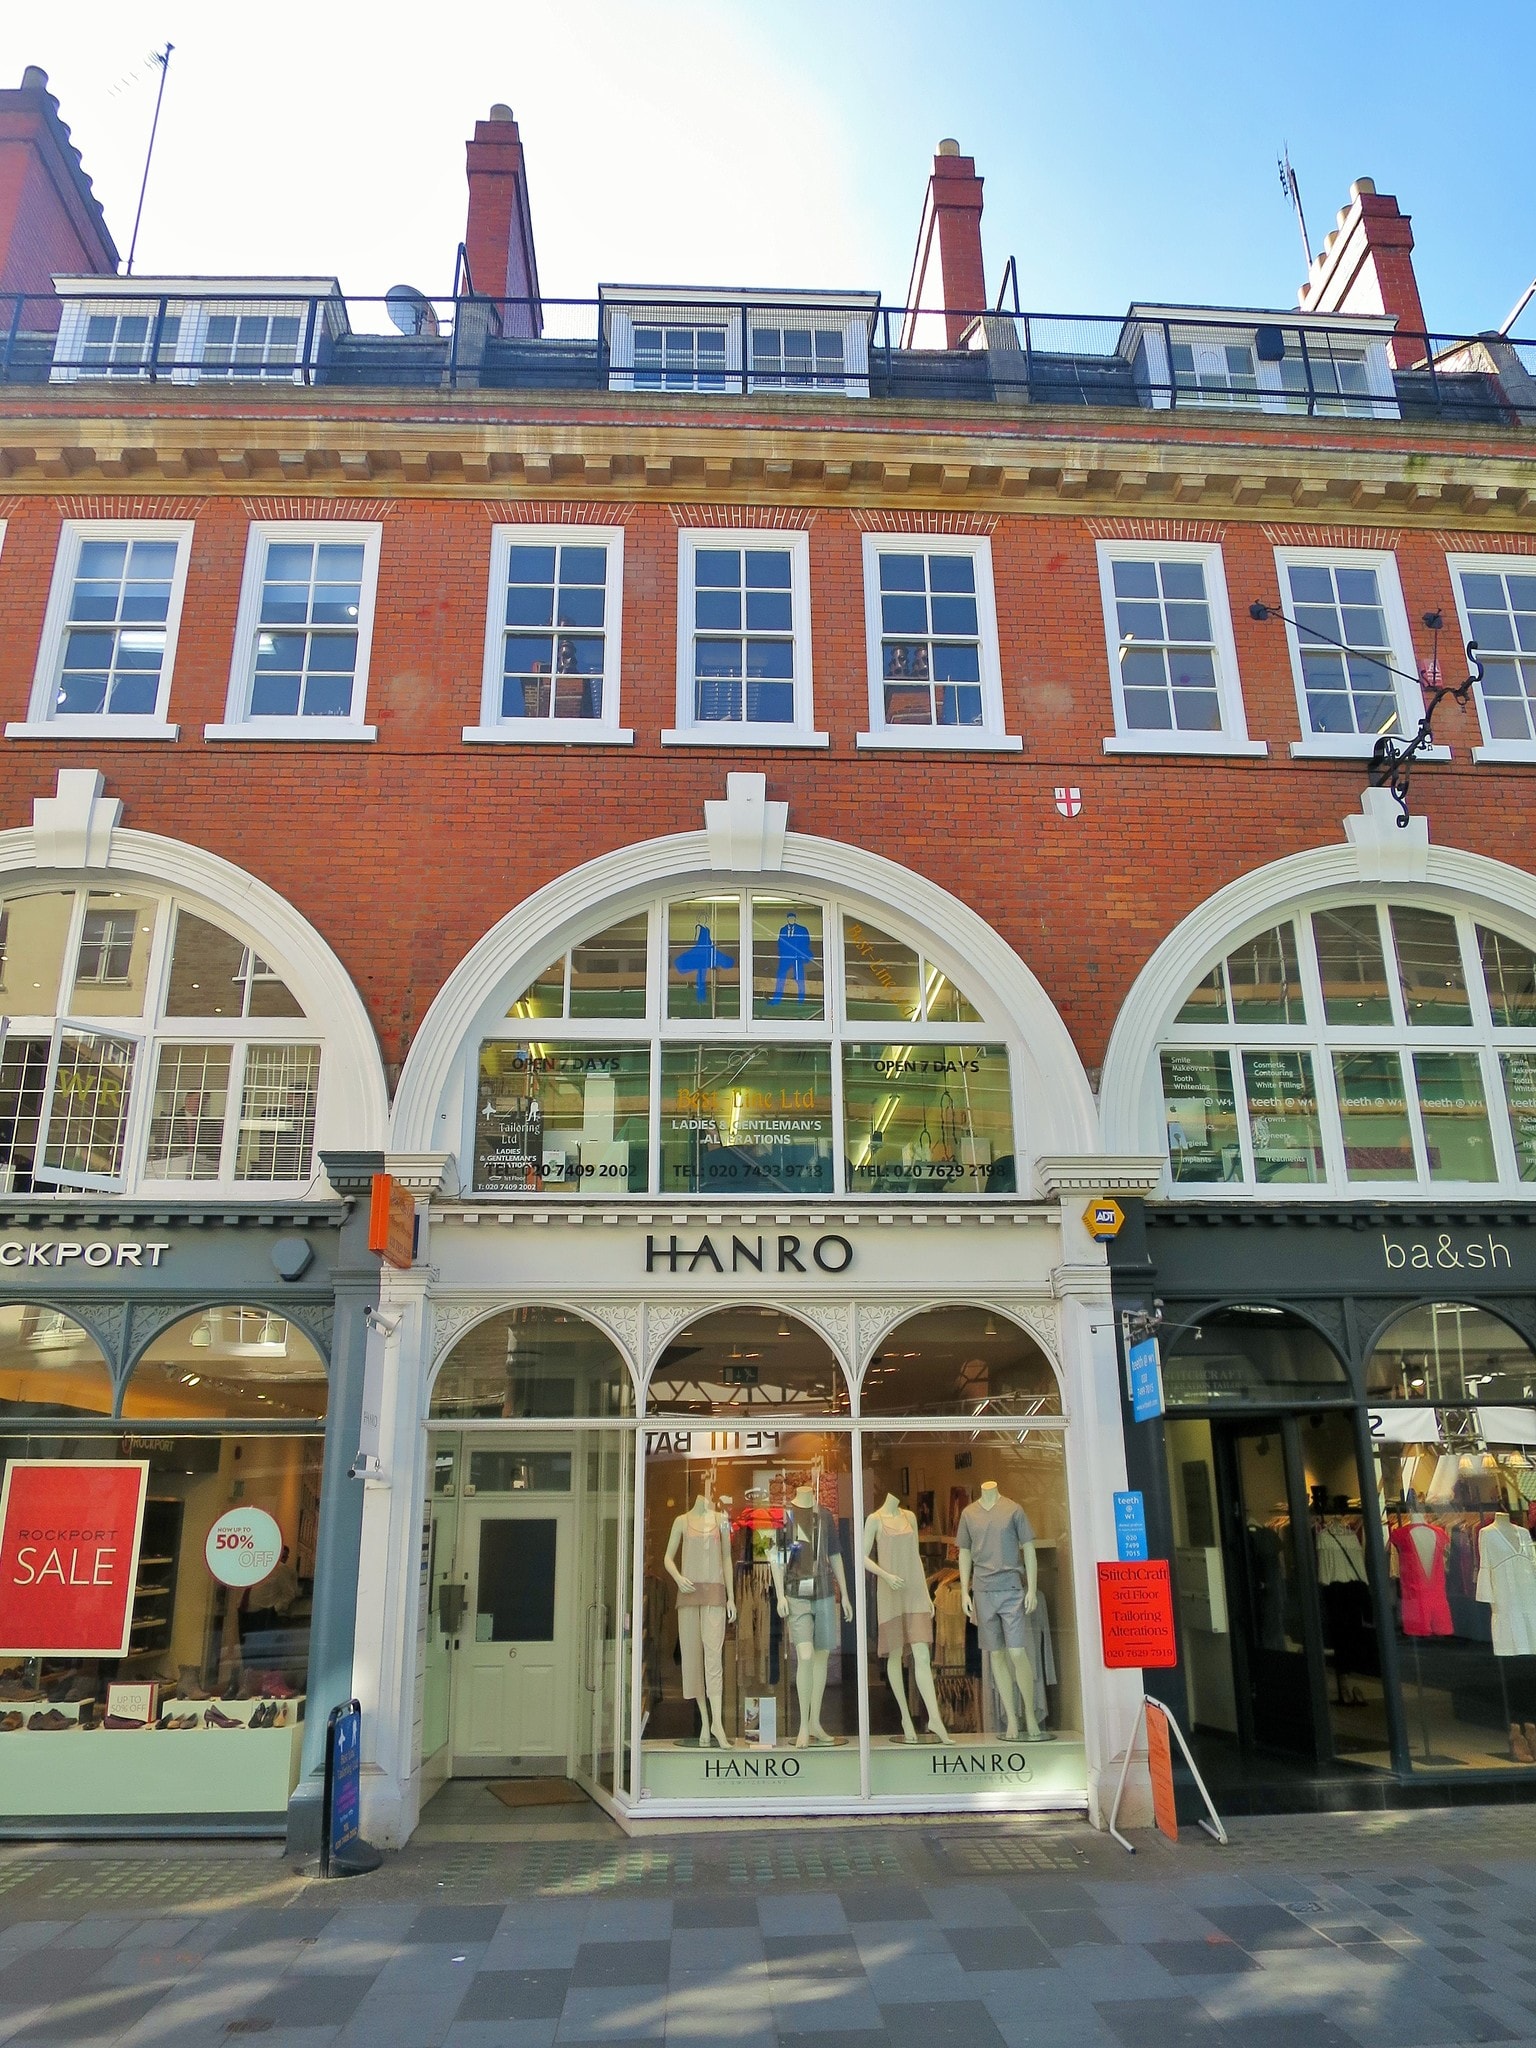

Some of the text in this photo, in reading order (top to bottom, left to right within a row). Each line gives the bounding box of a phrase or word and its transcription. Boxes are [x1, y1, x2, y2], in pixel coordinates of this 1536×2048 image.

[512, 1057, 620, 1070] OPEN 7 DAYS
[873, 1060, 980, 1073] OPEN 7 DAYS
[1254, 1069, 1293, 1077] Contouring
[1173, 1083, 1210, 1091] Whitening
[1255, 1081, 1304, 1090] White Fillings
[781, 1087, 816, 1108] Ltd
[1251, 1097, 1282, 1107] teeth
[1285, 1098, 1295, 1108] @
[1342, 1096, 1372, 1107] teeth
[1375, 1098, 1384, 1107] @
[1423, 1098, 1453, 1108] teeth
[1456, 1098, 1465, 1108] @
[499, 1122, 541, 1135] Tailoring
[672, 1120, 822, 1130] LADIES & GENTLEMAN'S
[502, 1135, 517, 1144] Ltd
[556, 1164, 595, 1177] 7409
[598, 1164, 637, 1177] 2002
[709, 1165, 738, 1177] 020
[858, 1165, 1005, 1177] TEL: 020 7629 2198
[1096, 1211, 1115, 1222] ADT
[0, 1242, 169, 1267] CKPORT
[645, 1234, 853, 1273] HANRO
[1382, 1233, 1511, 1269] ba&sh
[19, 1529, 118, 1540] ROCKPORT
[216, 1533, 254, 1549] 50%
[239, 1551, 274, 1567] OFF
[13, 1547, 117, 1585] SALE
[1100, 1568, 1168, 1581] StitchCraft
[1113, 1590, 1159, 1600] 3rd Floor
[1112, 1610, 1162, 1622] Tailoring
[1109, 1625, 1168, 1636] Alterations
[1107, 1649, 1124, 1657] 020
[116, 1695, 142, 1704] UP TO
[111, 1704, 146, 1713] 50% OFF
[705, 1757, 800, 1777] HANRO
[933, 1752, 1025, 1773] HANRO
